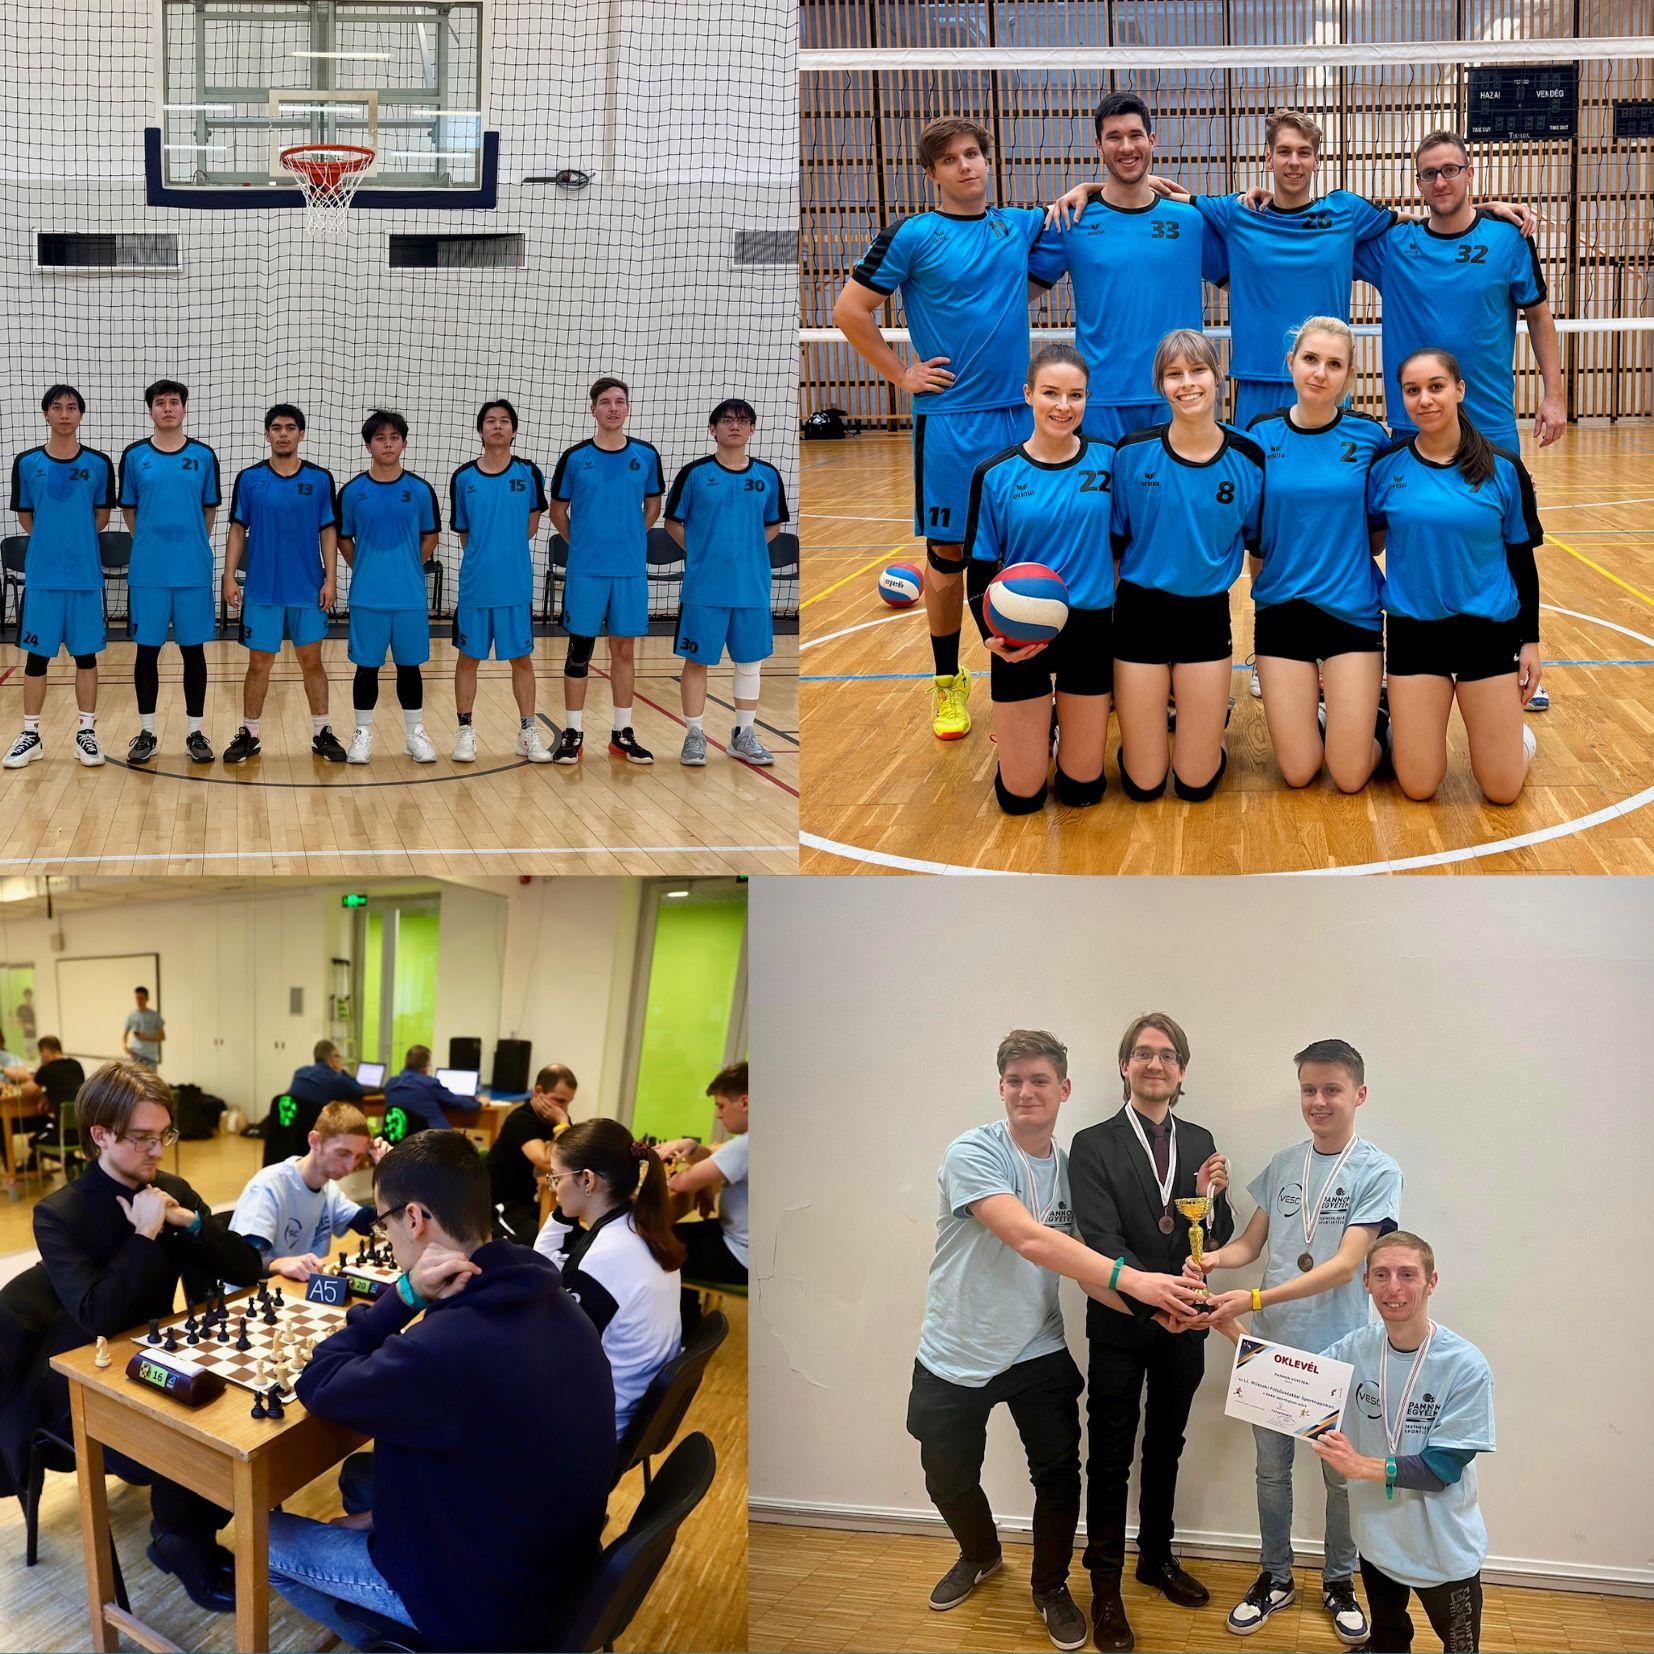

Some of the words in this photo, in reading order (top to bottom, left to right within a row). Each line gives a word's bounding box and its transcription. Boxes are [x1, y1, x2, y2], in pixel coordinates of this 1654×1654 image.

[1480, 91, 1501, 99] HAZAI
[1536, 88, 1564, 98] VENDÉG
[1151, 220, 1180, 239] 33
[1455, 244, 1489, 264] 32
[1341, 442, 1357, 462] 2
[182, 457, 199, 472] 21
[629, 457, 640, 471] 6
[69, 467, 90, 481] 24
[509, 479, 526, 492] 15
[743, 478, 766, 492] 30
[1079, 470, 1112, 493] 22
[297, 482, 313, 496] 13
[401, 490, 412, 502] 3
[1216, 481, 1235, 504] 8
[929, 506, 951, 528] 11
[23, 631, 39, 648] 24
[680, 637, 699, 653] 30
[1280, 1194, 1301, 1205] VESC
[309, 1279, 338, 1302] A5
[357, 1281, 367, 1290] 20
[1274, 1354, 1319, 1374] OKLEVÉL
[153, 1370, 164, 1382] 16
